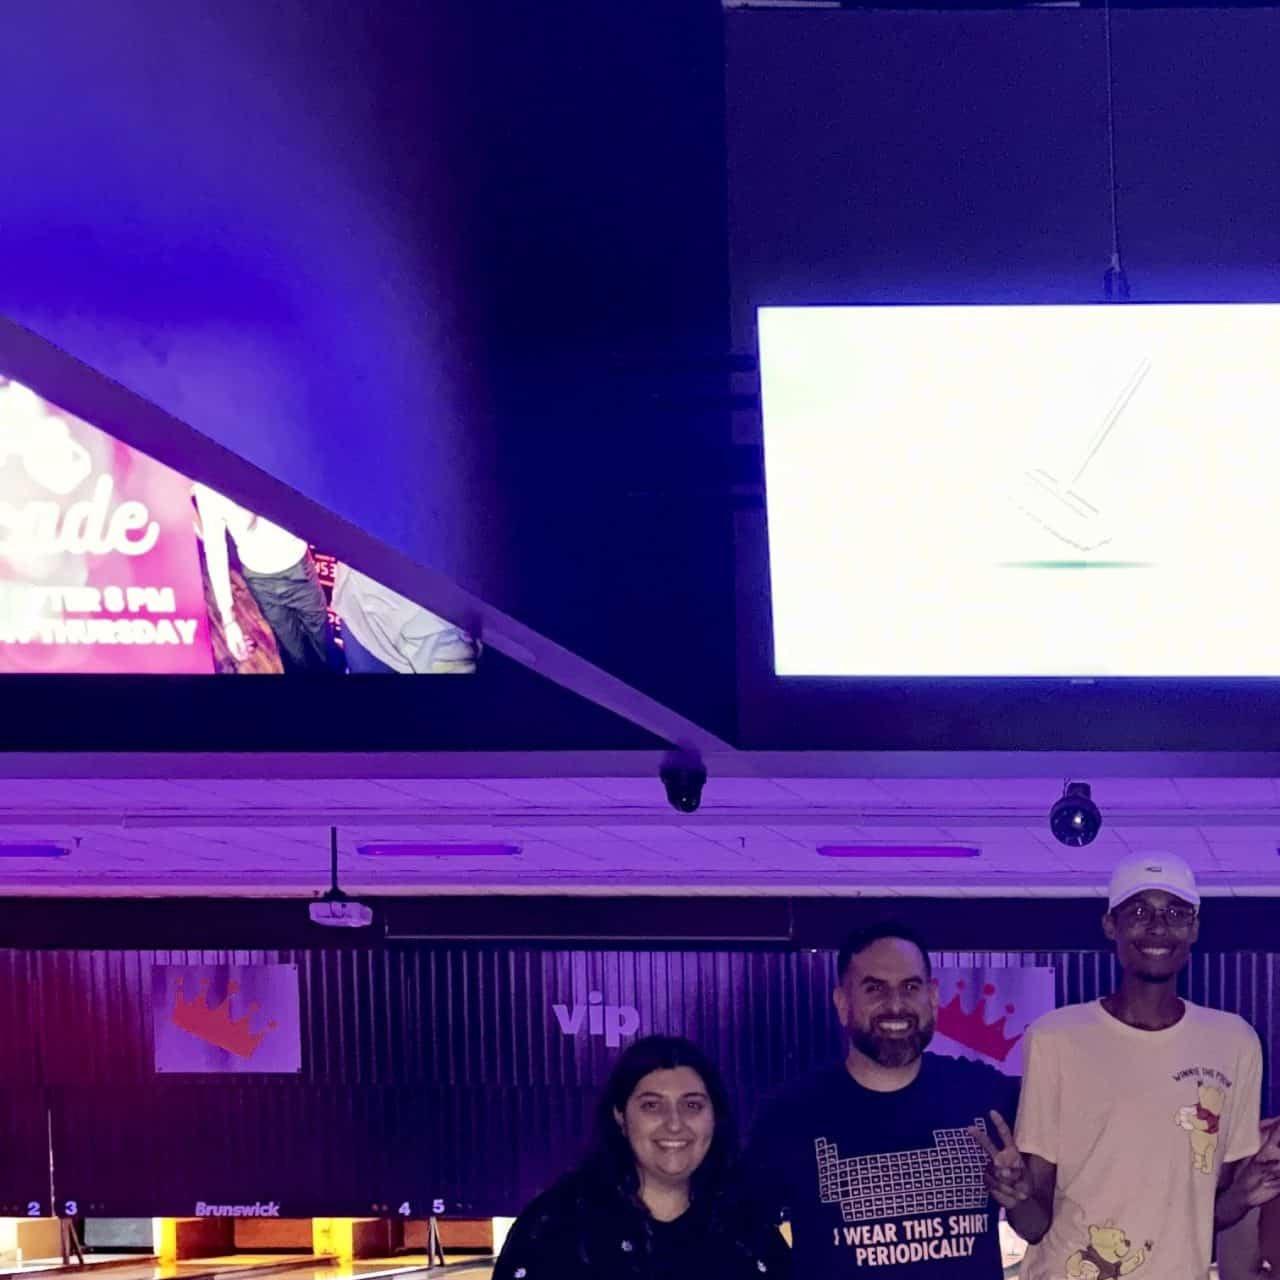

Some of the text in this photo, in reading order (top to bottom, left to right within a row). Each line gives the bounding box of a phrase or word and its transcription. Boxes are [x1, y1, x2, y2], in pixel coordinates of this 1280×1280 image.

[127, 587, 176, 612] PM
[551, 990, 640, 1048] vip
[27, 1202, 40, 1215] 2
[65, 1201, 78, 1215] 3
[195, 1201, 280, 1217] Brunswick
[398, 1201, 411, 1216] 4
[432, 1199, 446, 1214] 5
[843, 1223, 897, 1246] WEAR
[902, 1217, 944, 1240] THIS
[949, 1213, 989, 1235] SHIRT
[855, 1236, 975, 1267] PERIODICALLY
